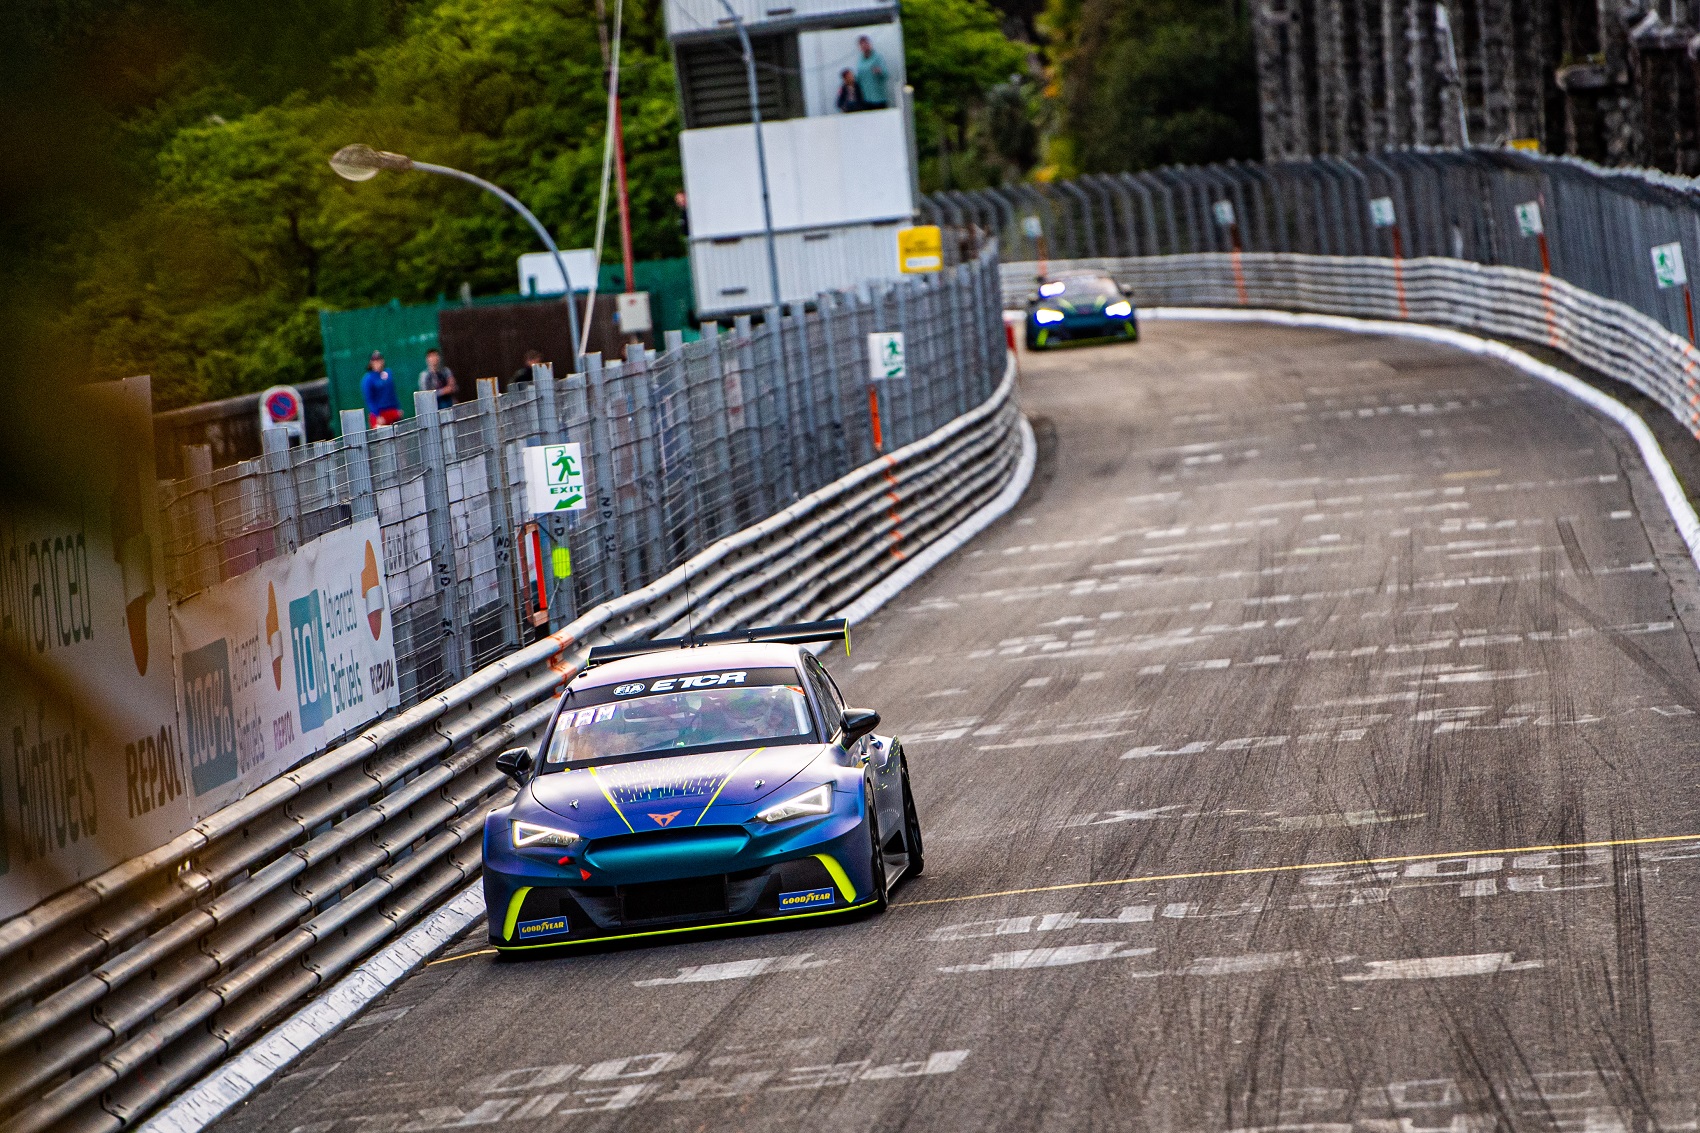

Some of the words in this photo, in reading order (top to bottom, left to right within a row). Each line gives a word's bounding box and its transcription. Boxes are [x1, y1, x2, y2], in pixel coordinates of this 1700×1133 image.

[550, 485, 583, 494] EXIT
[370, 658, 395, 696] REPSOL
[650, 671, 748, 692] ETCR
[615, 683, 645, 696] FIA
[273, 710, 295, 751] REPSOL
[126, 725, 182, 819] REPSOL
[782, 891, 831, 905] GOODYEAR
[521, 920, 564, 933] GOODYEAR
